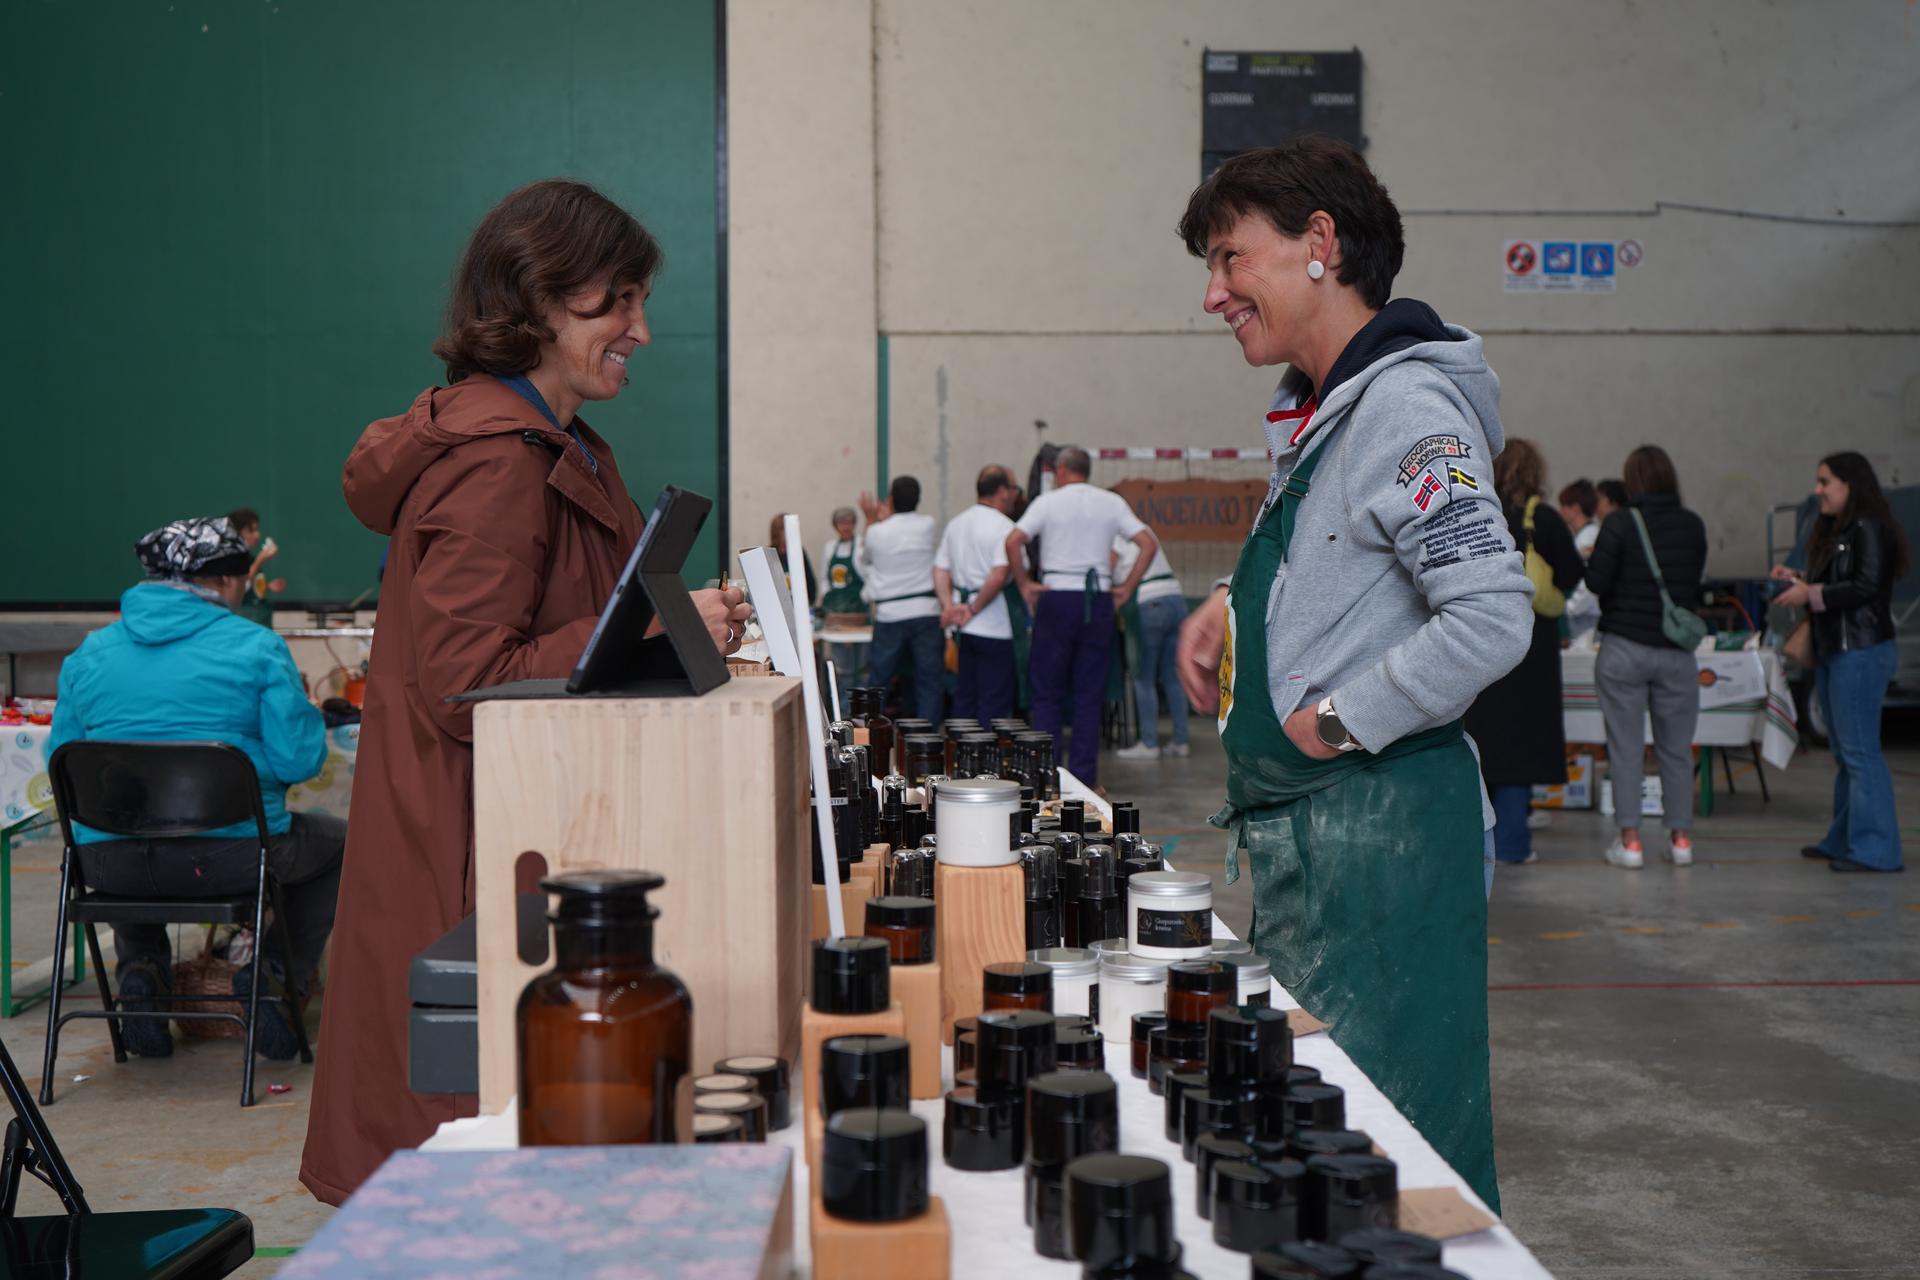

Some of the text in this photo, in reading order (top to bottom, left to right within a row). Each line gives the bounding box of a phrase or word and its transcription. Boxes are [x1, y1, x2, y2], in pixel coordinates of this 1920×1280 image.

[1403, 437, 1457, 469] GEOGRAPHICAL
[1409, 465, 1418, 475] 19
[1416, 446, 1446, 467] NORWAY
